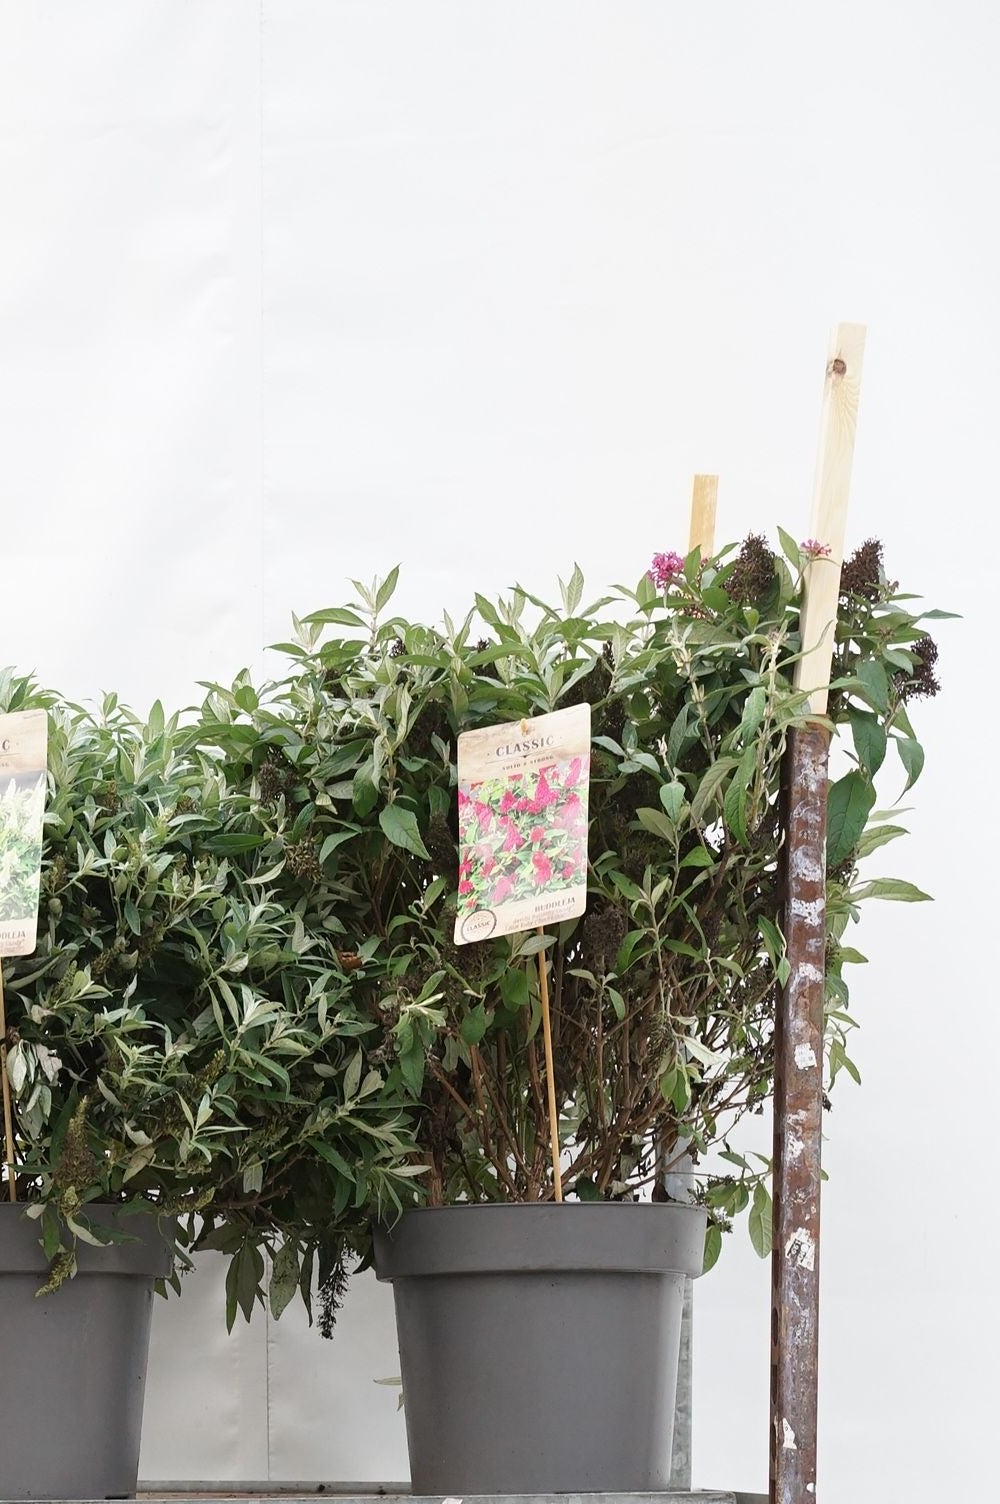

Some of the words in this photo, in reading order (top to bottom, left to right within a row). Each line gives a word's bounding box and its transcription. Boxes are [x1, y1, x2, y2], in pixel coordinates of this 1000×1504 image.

[496, 736, 554, 757] CLASSIC
[534, 897, 576, 912] BUDDLEJA
[466, 920, 490, 932] CLASSIC
